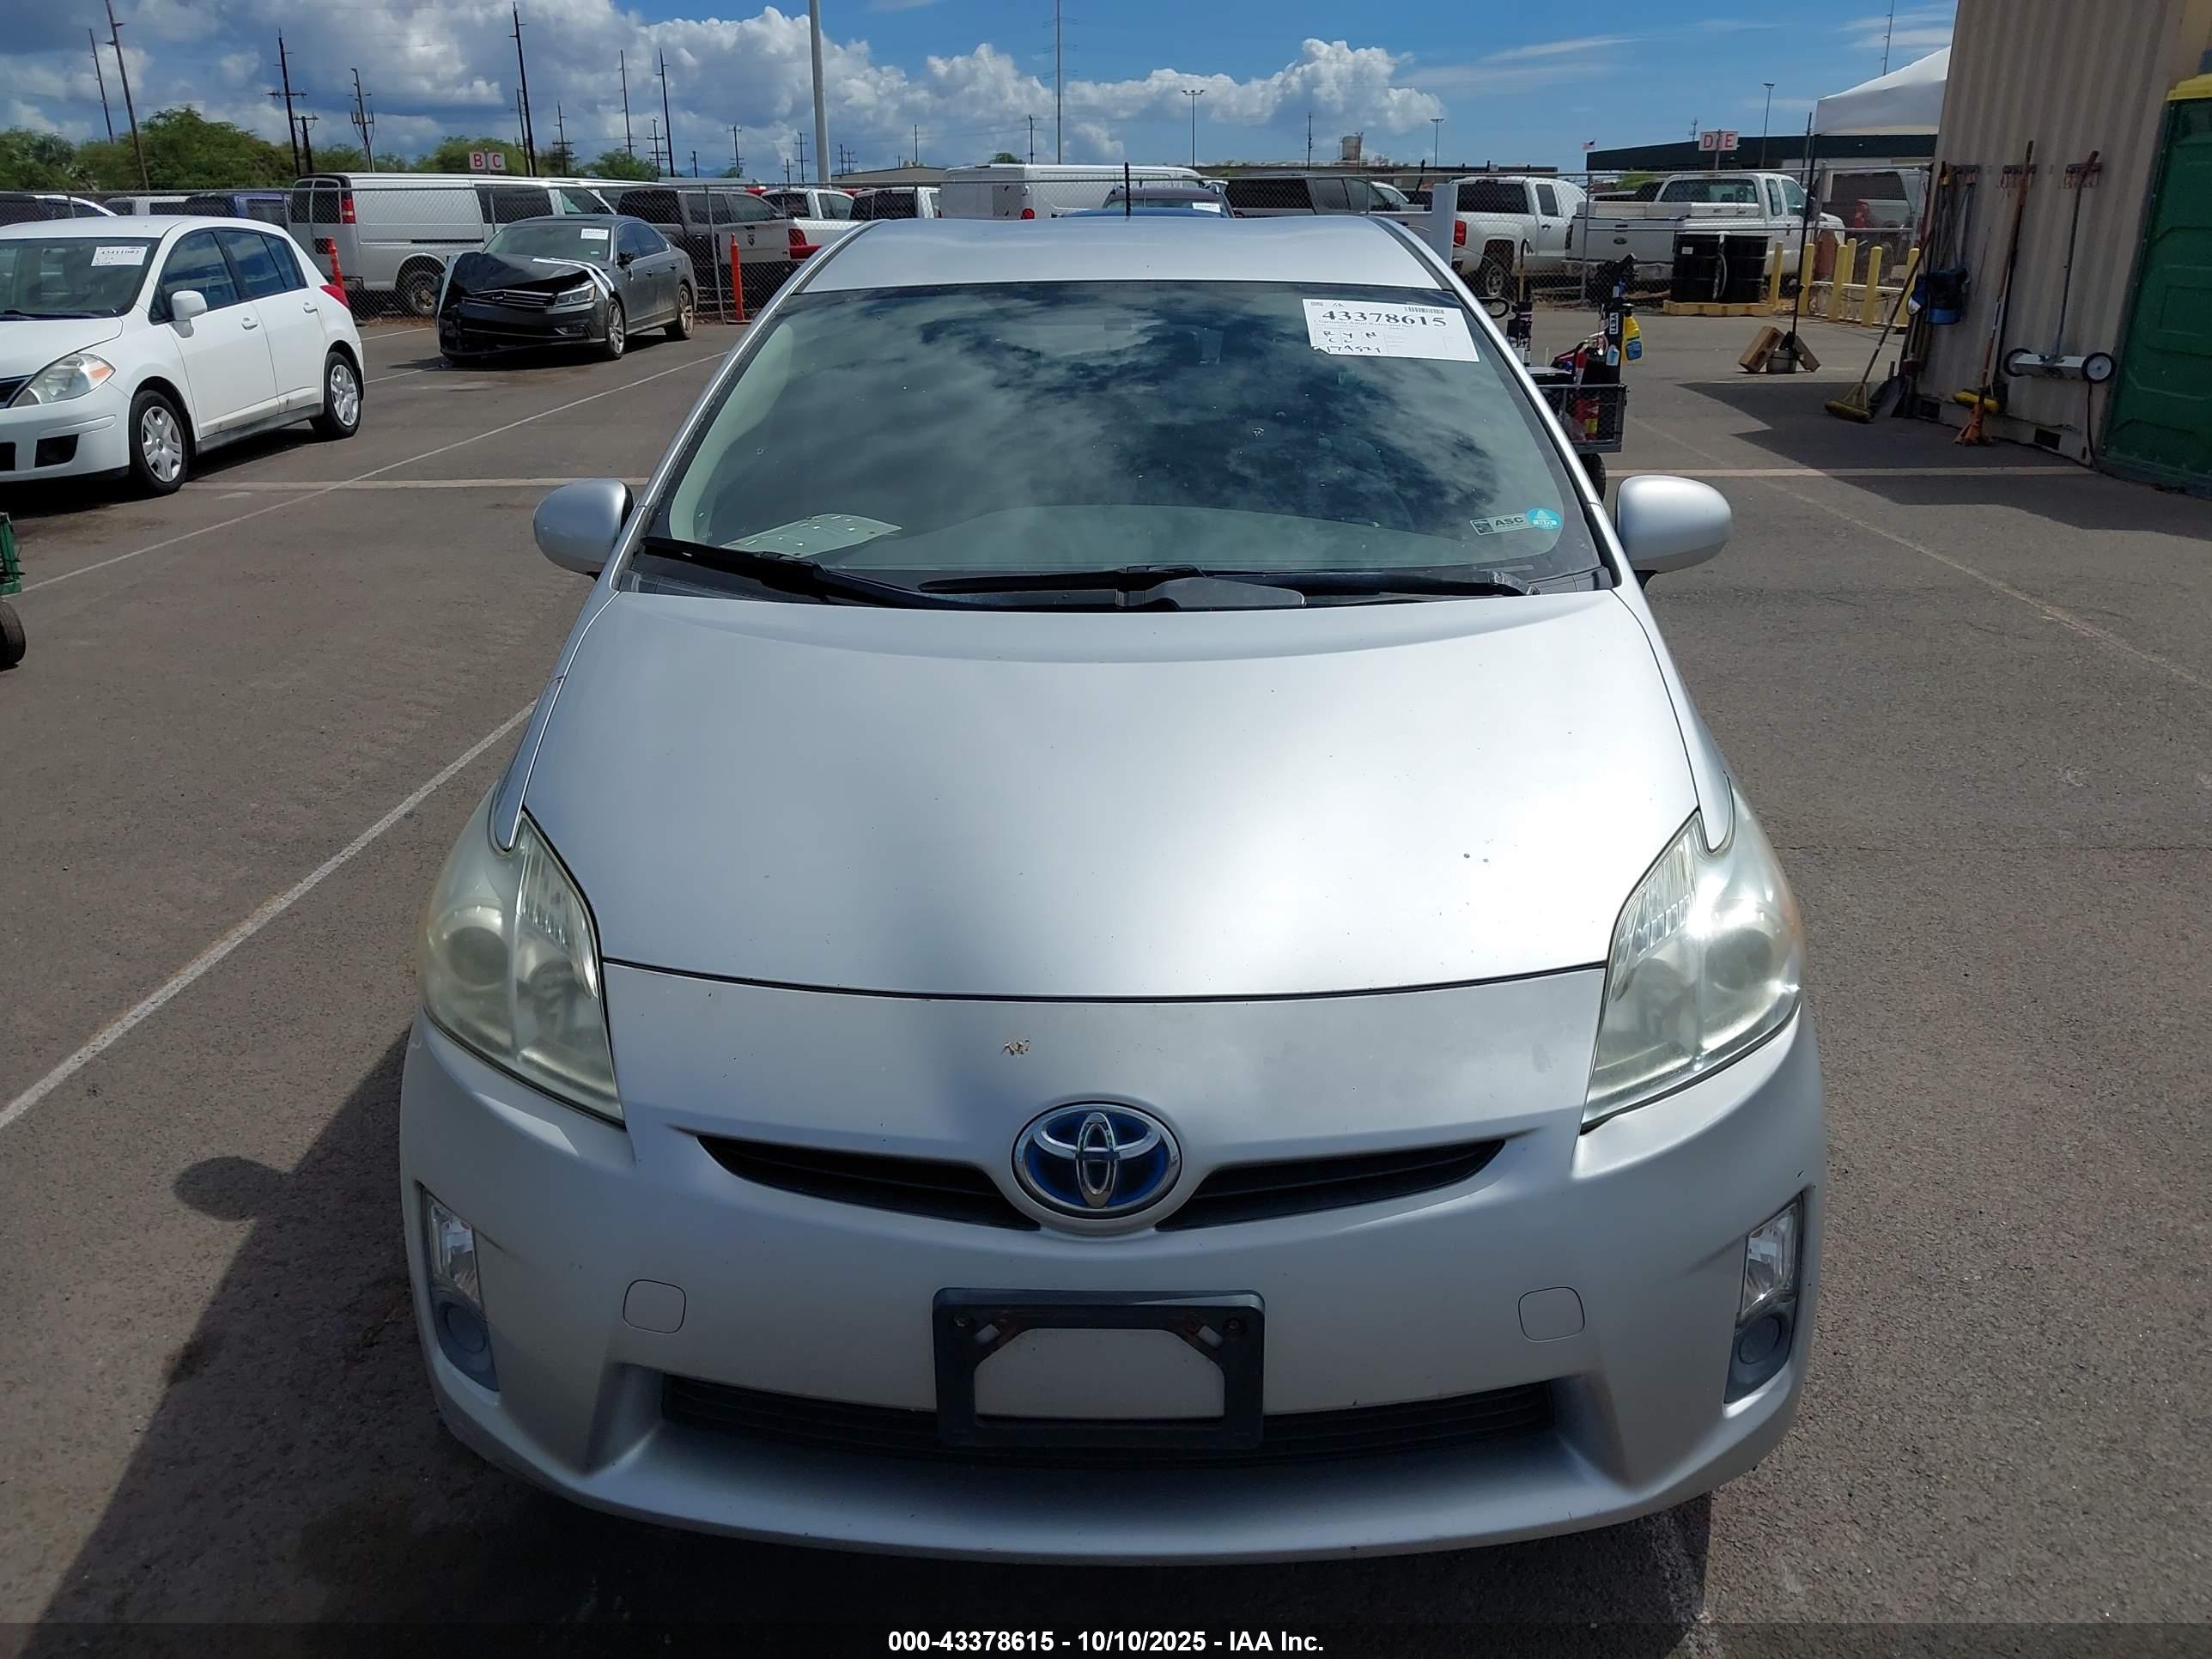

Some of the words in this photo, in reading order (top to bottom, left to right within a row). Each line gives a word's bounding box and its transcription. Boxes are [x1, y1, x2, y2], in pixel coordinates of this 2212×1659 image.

[1704, 135, 1713, 148] D
[1724, 134, 1735, 148] E
[474, 154, 482, 167] B
[492, 155, 501, 167] C
[1322, 310, 1447, 327] 43378615
[1495, 516, 1524, 526] ASC
